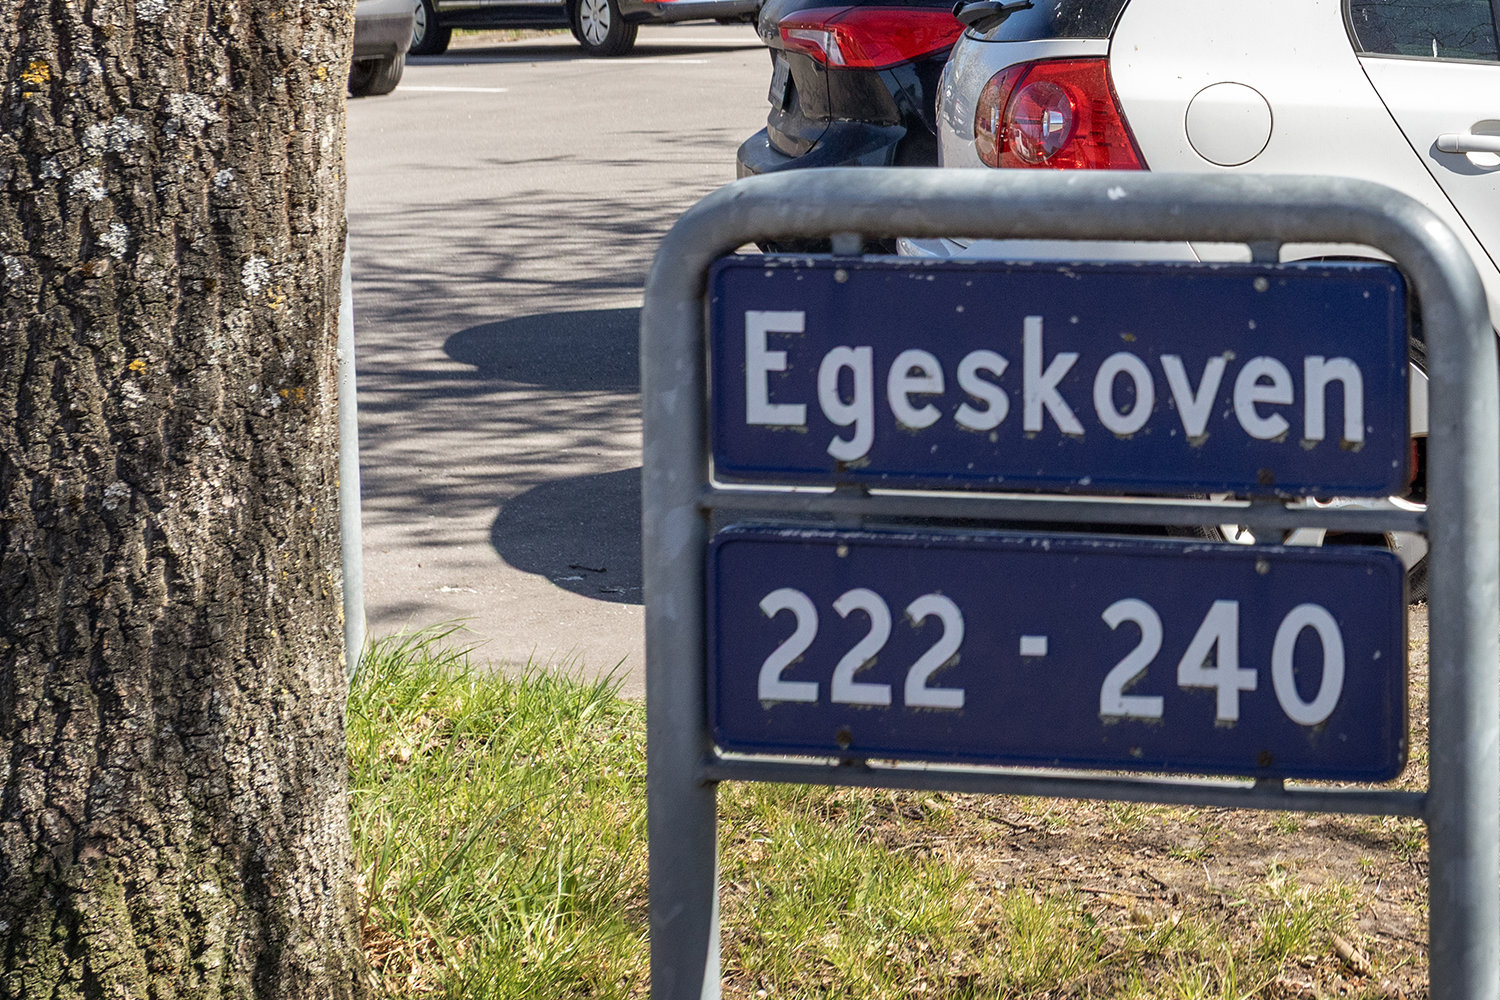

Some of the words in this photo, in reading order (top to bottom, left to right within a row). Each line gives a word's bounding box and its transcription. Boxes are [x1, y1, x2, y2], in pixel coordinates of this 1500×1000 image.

[746, 311, 1363, 461] Egeskoven
[758, 588, 965, 709] 222
[1019, 635, 1047, 656] -
[1100, 599, 1345, 726] 240
